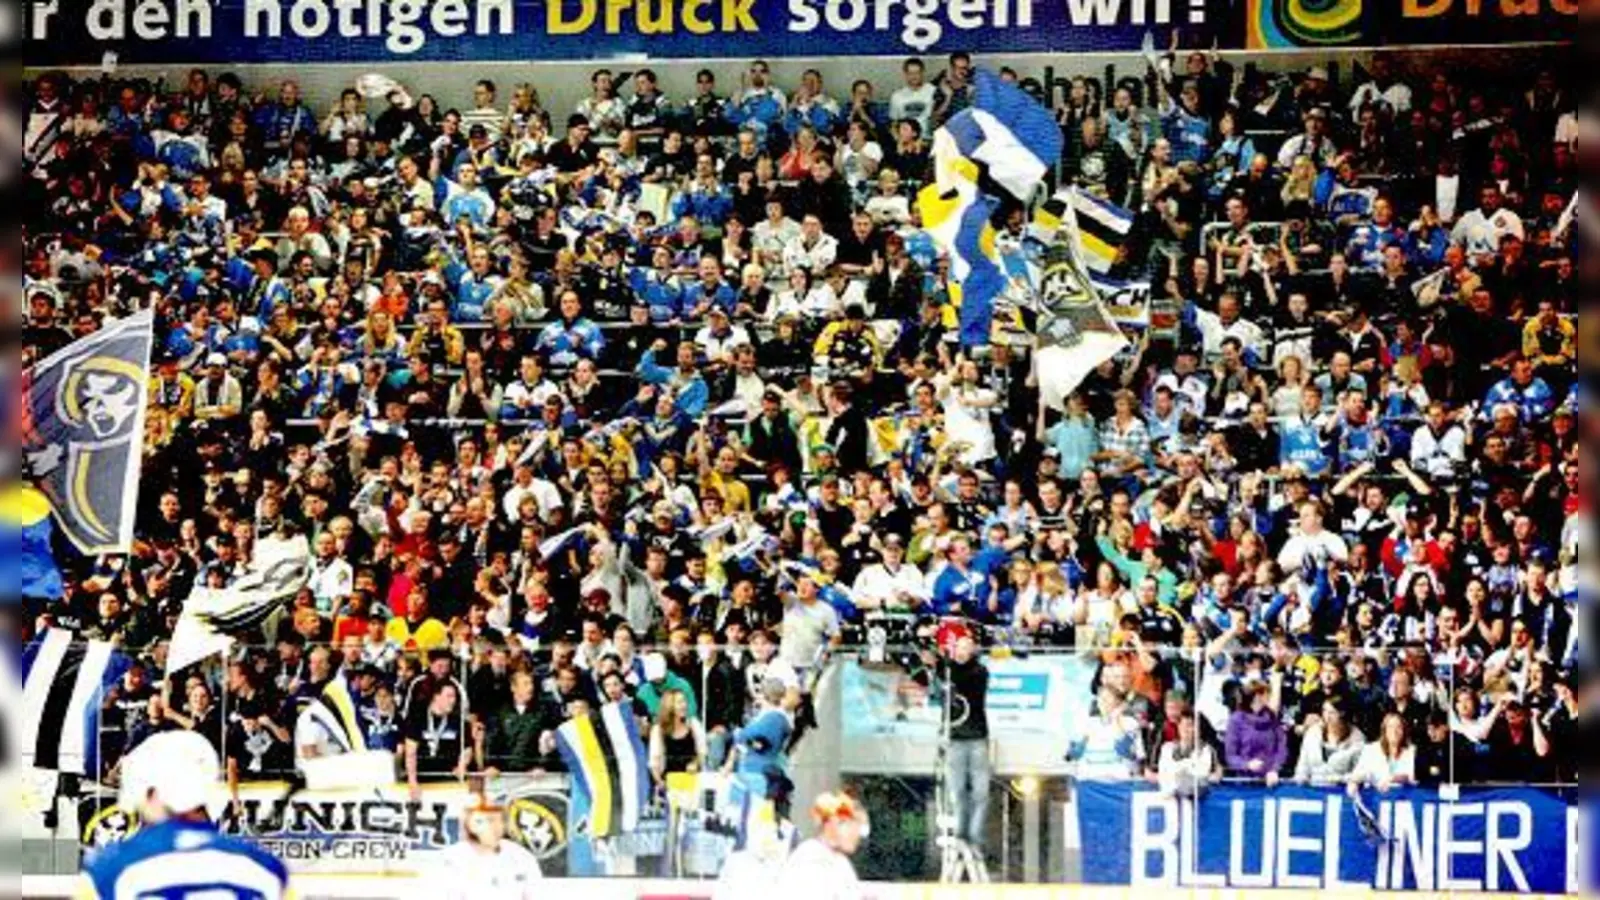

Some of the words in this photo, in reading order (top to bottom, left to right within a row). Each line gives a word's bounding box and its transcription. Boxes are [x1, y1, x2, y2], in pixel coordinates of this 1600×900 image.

[86, 0, 213, 39] den
[546, 0, 760, 34] Druck
[788, 0, 1032, 50] sorgen
[1130, 791, 1532, 892] BLUELINER
